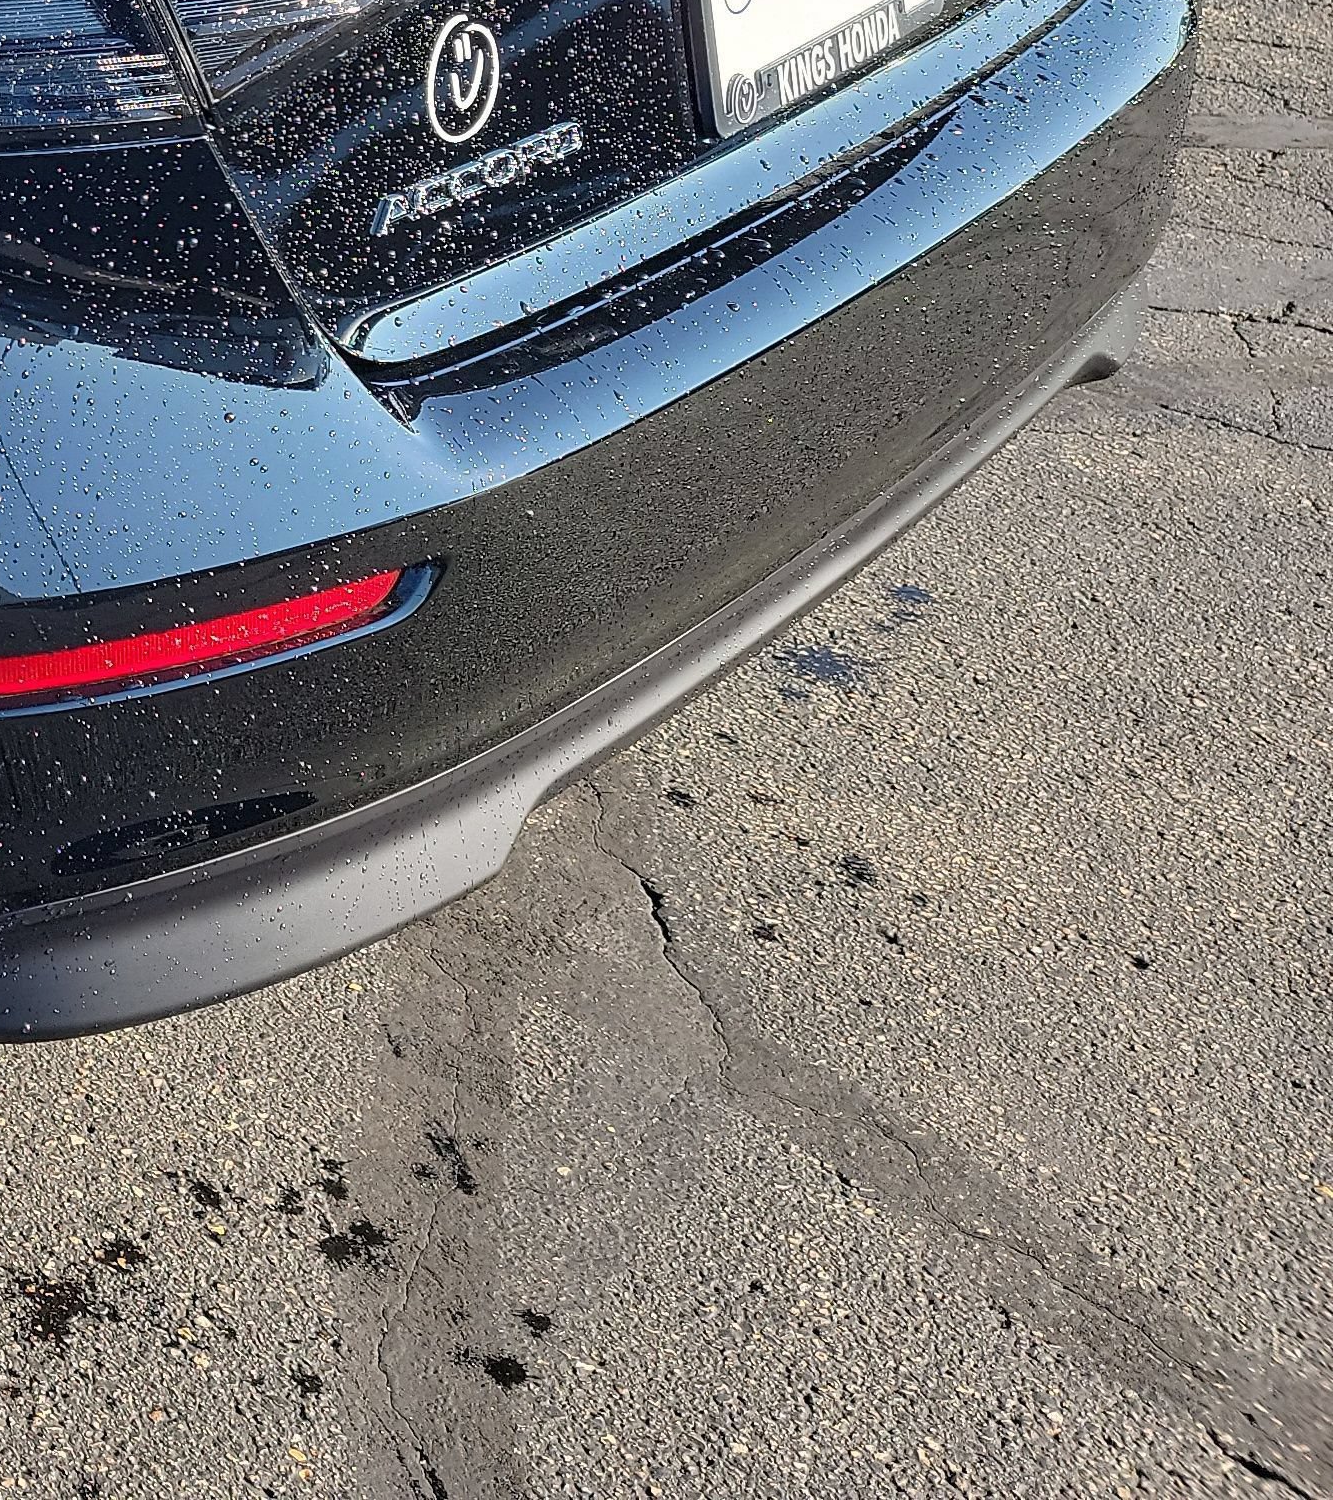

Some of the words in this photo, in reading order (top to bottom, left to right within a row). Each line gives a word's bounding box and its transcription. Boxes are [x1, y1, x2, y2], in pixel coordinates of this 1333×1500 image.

[777, 40, 834, 107] KINGS
[835, 4, 900, 70] HONDA
[370, 121, 583, 235] ACCORD
